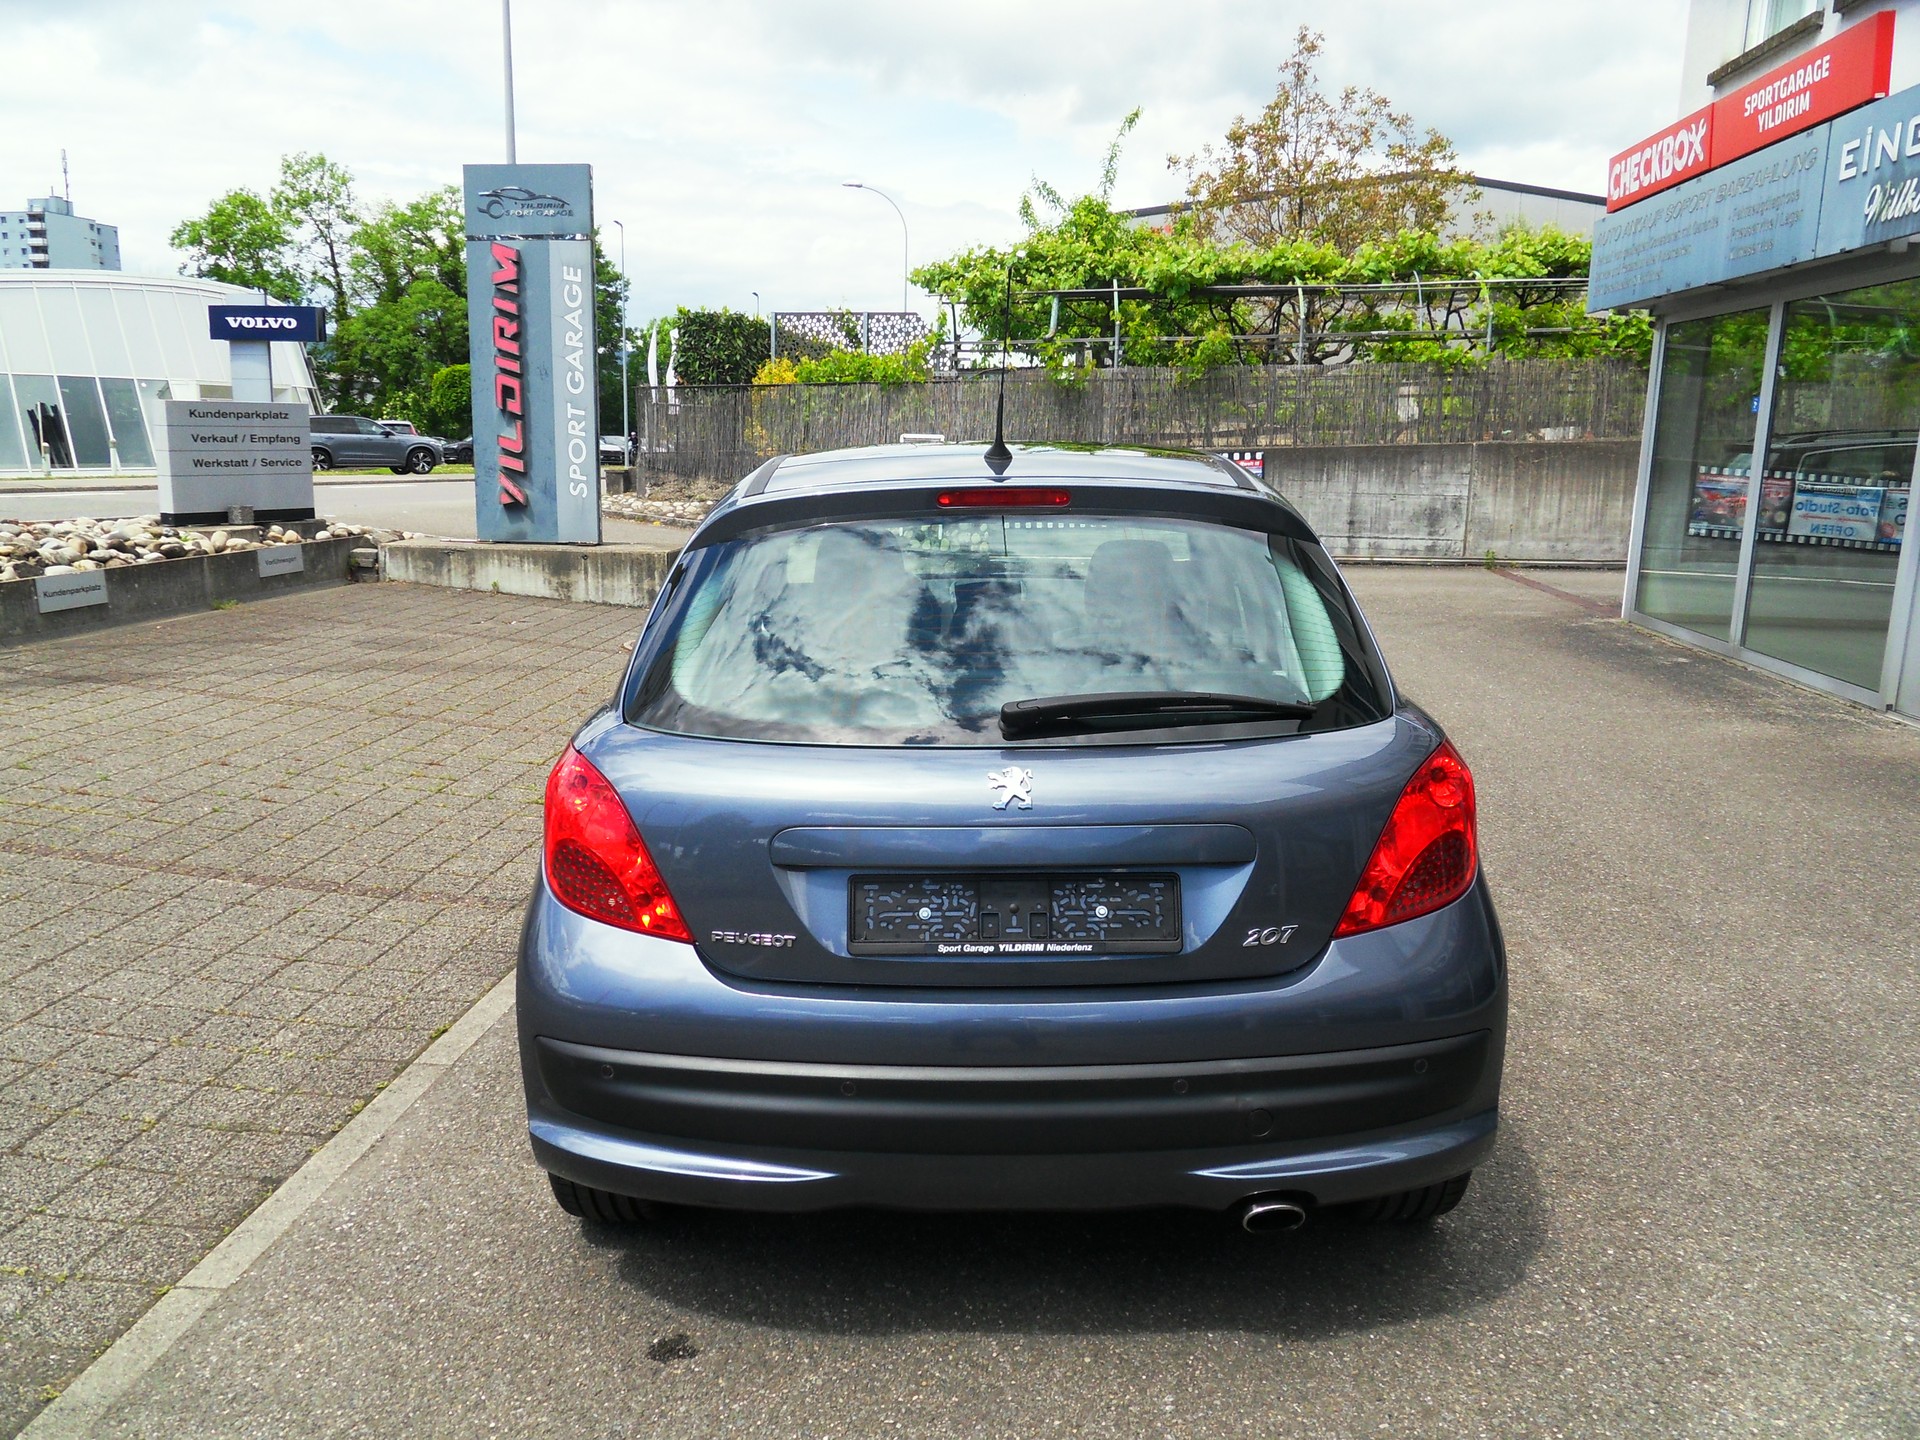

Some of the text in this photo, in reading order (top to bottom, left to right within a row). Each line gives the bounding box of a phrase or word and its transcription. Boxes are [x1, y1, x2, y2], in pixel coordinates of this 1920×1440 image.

[1744, 55, 1830, 117] SPORTGARAGE
[1758, 91, 1810, 133] YILDIRIM
[1610, 118, 1707, 201] CHECKBOX
[1665, 187, 1715, 222] SOFORT
[1715, 147, 1819, 204] BARZAHLUNG
[505, 209, 574, 217] SPORT GARAGE
[225, 316, 298, 329] VOLVO
[490, 241, 526, 506] YILDIRIM
[562, 265, 588, 498] SPORT GARAGE
[189, 408, 289, 421] Kundenparkplatz
[191, 433, 238, 444] Verkauf
[250, 433, 301, 445] Empfang
[193, 458, 249, 468] Werkstatt
[260, 457, 302, 467] Service
[43, 584, 102, 598] Kundenparkplatz
[711, 930, 796, 948] PEUGEOT
[1242, 924, 1299, 948] 207
[938, 943, 1093, 953] Sport Garage YILDIRIM Niederlenz
